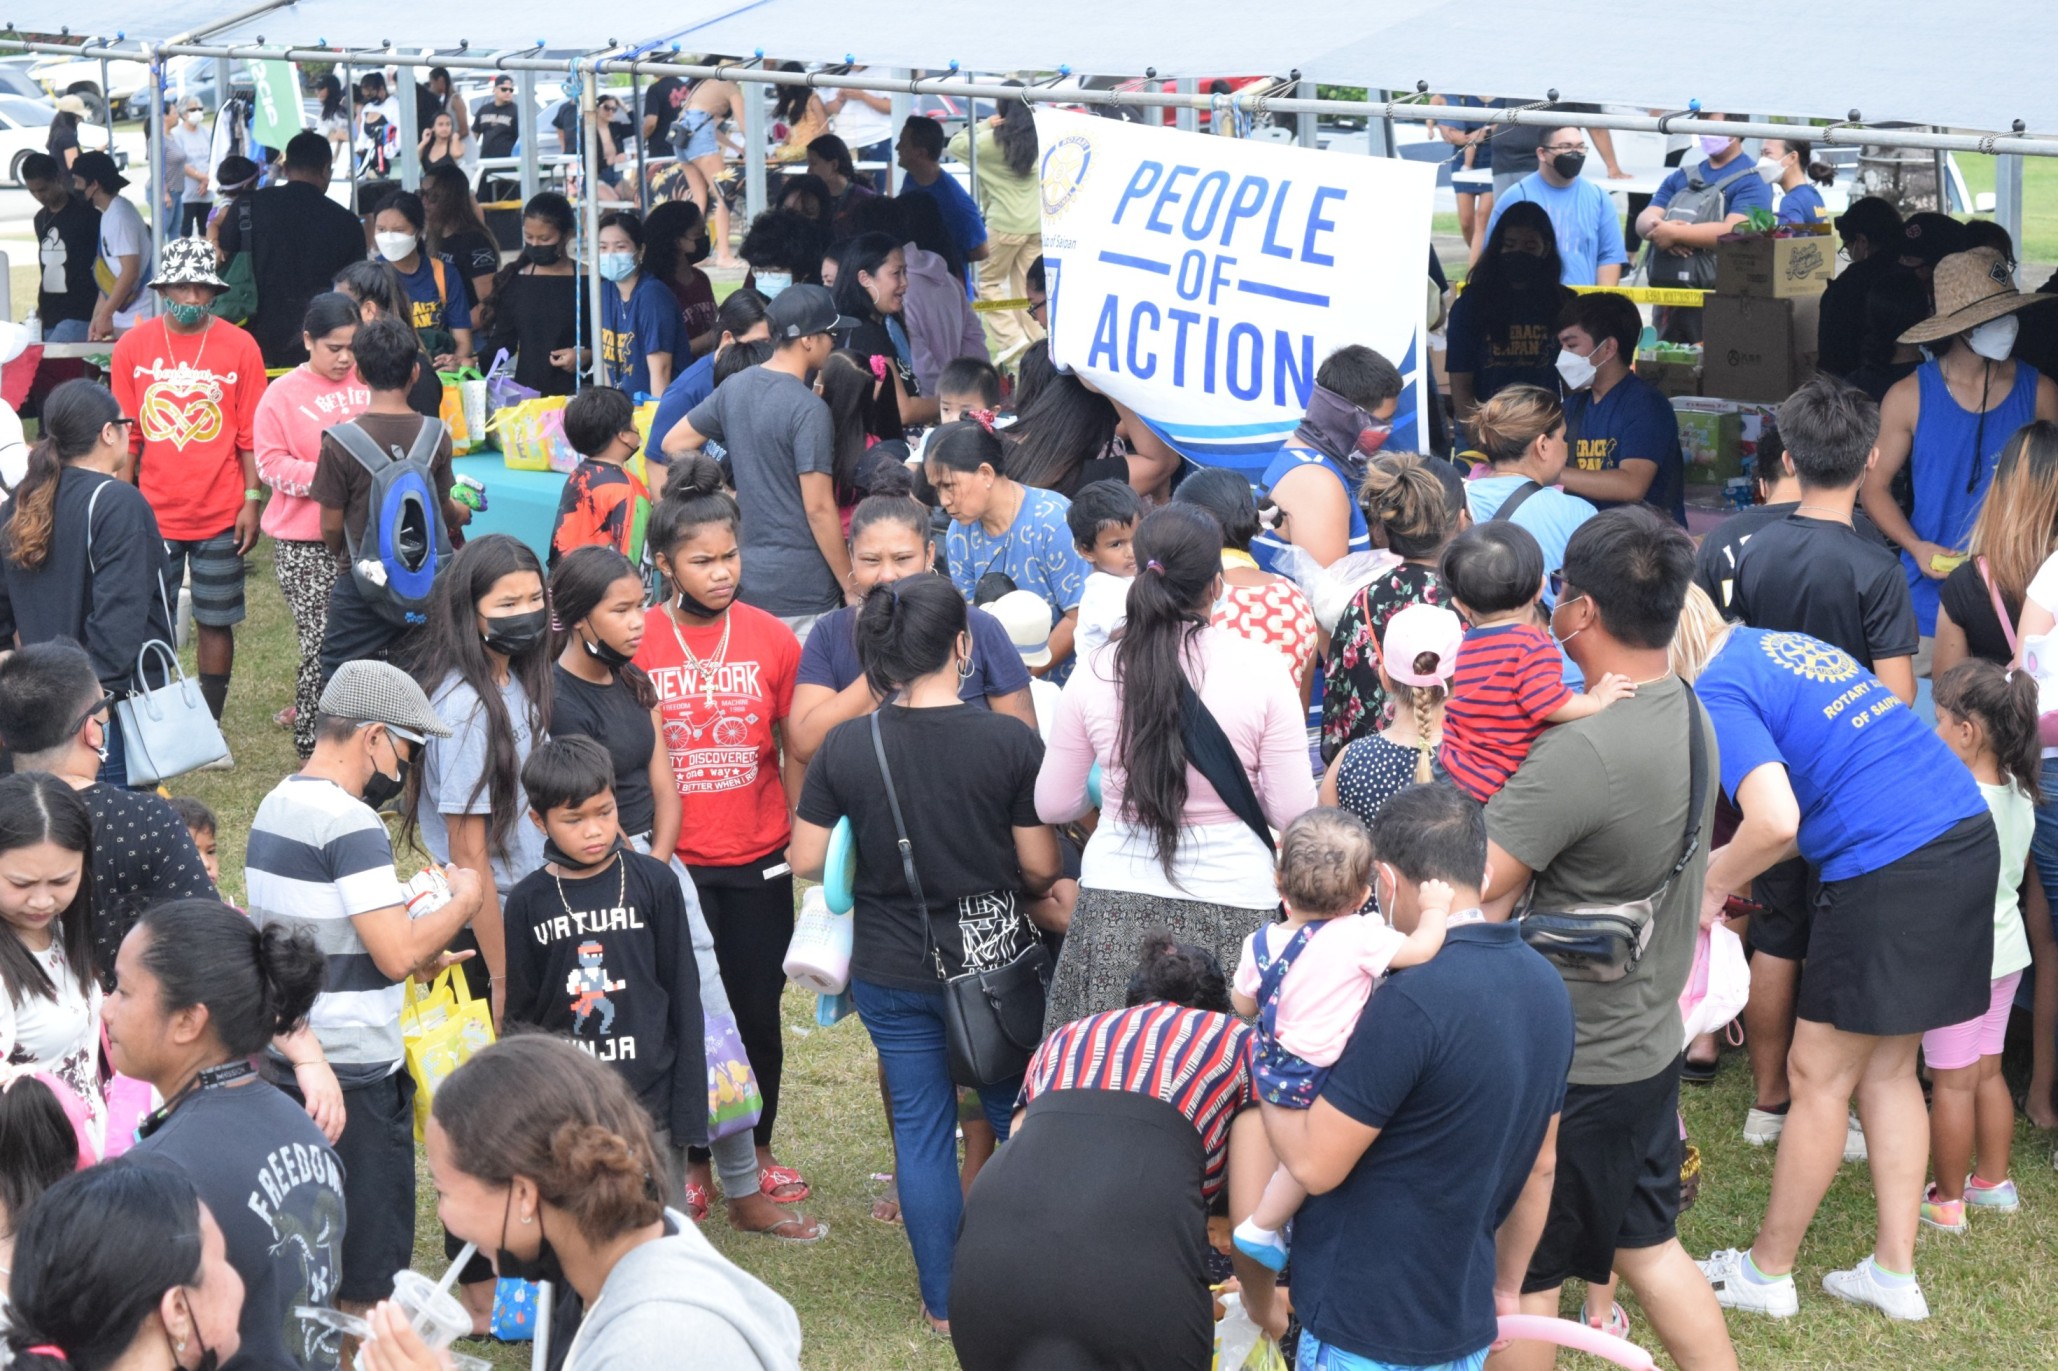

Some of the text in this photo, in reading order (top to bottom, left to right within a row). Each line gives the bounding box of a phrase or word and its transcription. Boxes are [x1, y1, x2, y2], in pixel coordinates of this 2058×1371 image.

[1111, 160, 1348, 267] PEOPLE
[1176, 249, 1237, 305] OF
[1087, 294, 1314, 410] ACTION
[1823, 681, 1870, 720] ROTARY
[1852, 711, 1870, 728] OF
[686, 767, 730, 779] one way
[690, 751, 755, 766] DISCOVERED
[715, 778, 740, 790] WHEN
[534, 907, 644, 945] VIRTUAL
[248, 1142, 342, 1241] FREEDOM
